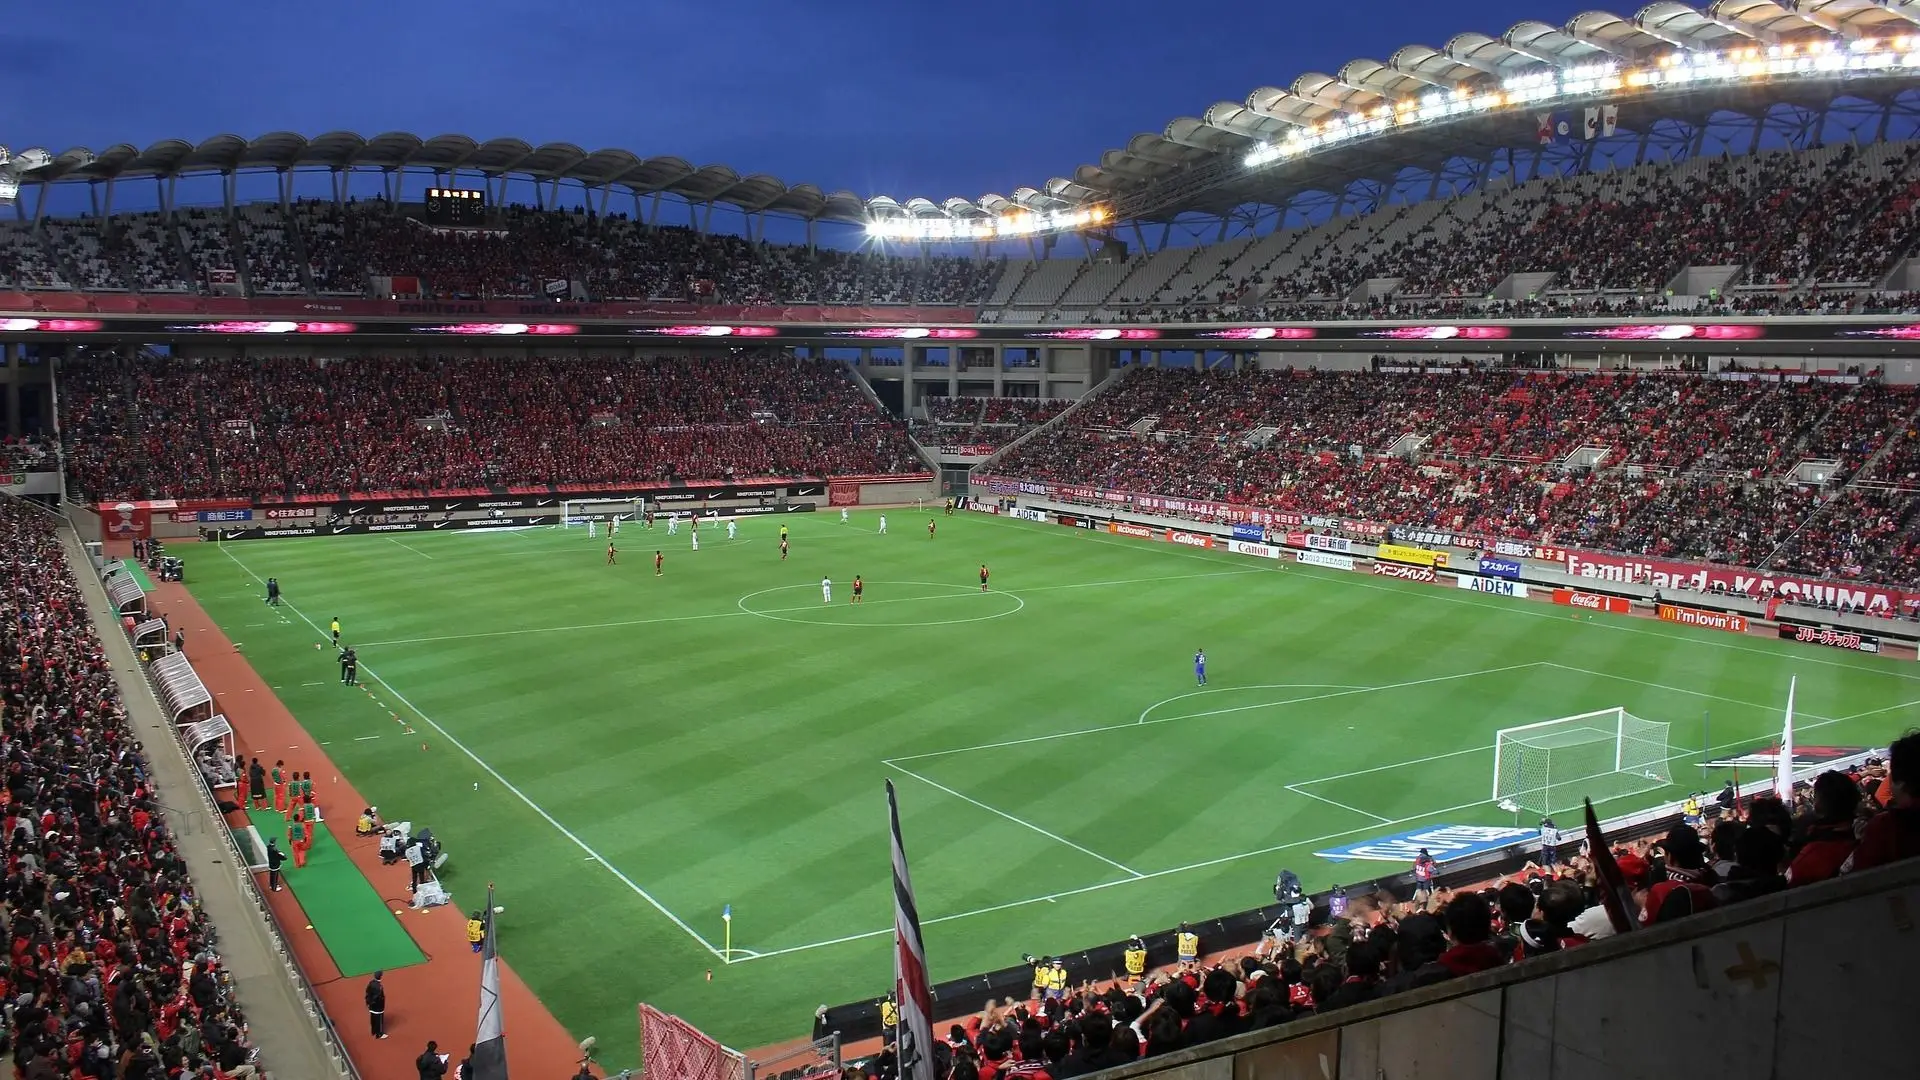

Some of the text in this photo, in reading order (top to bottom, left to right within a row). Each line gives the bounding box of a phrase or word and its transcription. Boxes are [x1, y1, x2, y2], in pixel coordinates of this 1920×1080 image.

[969, 501, 995, 513] KONAMI
[207, 511, 245, 521] 商船三井
[1172, 532, 1206, 547] Calbee
[1310, 536, 1348, 551] 朝日新聞
[1238, 542, 1269, 556] Canon
[1495, 541, 1533, 557] 佐藤昭大
[1374, 563, 1434, 581] ウイニングイレブン
[1677, 608, 1695, 623] i'm
[1731, 617, 1741, 630] it
